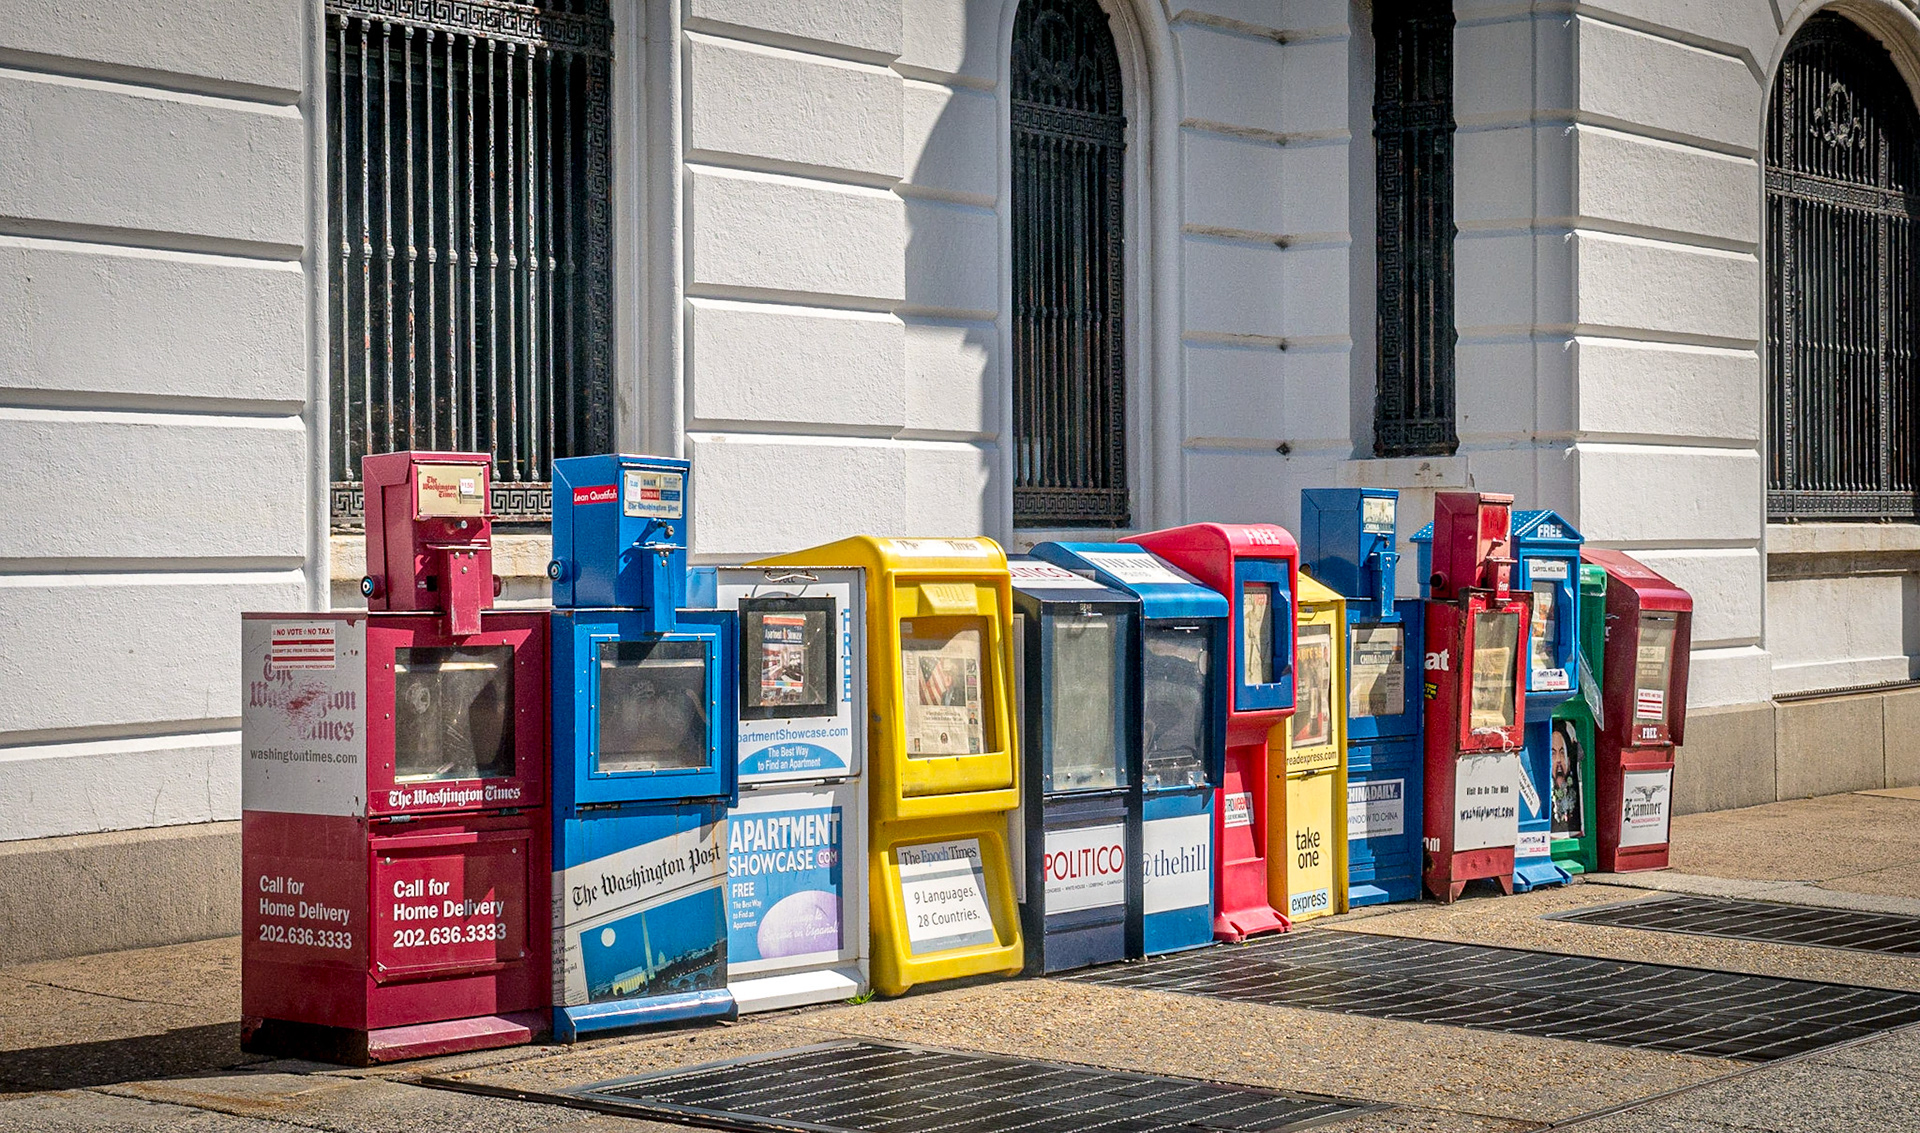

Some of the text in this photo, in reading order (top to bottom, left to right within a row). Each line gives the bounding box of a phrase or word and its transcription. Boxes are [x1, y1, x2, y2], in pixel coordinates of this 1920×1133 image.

[574, 492, 588, 502] Lean
[1243, 528, 1280, 545] FREE
[1537, 523, 1562, 538] FREE
[944, 540, 979, 551] Times
[276, 628, 285, 636] NO
[287, 628, 302, 636] VOTE
[318, 626, 330, 635] TAX
[1425, 648, 1449, 671] at
[1642, 727, 1657, 739] FREE
[250, 748, 357, 763] washingtontimes.com
[768, 745, 809, 758] The Best Way
[1286, 750, 1336, 766] readexpress.com
[758, 756, 821, 771] to Find an Apartment
[388, 784, 521, 808] The Washington Times
[1372, 813, 1379, 822] TO
[1380, 812, 1398, 822] CHINA
[729, 813, 840, 854] APARTMENT
[1296, 827, 1320, 851] take
[902, 845, 977, 867] The Epoch Times
[1044, 845, 1125, 882] POLITICO
[1298, 851, 1319, 870] one
[259, 876, 304, 895] Call for
[572, 884, 597, 909] The
[601, 857, 685, 897] Washington
[689, 843, 720, 873] Post
[393, 879, 449, 898] Call for
[732, 882, 755, 898] FREE
[914, 886, 977, 905] 9 Languages.
[393, 900, 504, 921] Home Delivery
[1291, 892, 1327, 912] express
[259, 899, 350, 926] Home Delivery
[918, 908, 980, 928] 28 Countries.
[733, 921, 757, 930] Apartment
[259, 925, 352, 949] 202.636.3333
[393, 923, 507, 948] 202.636.3333
